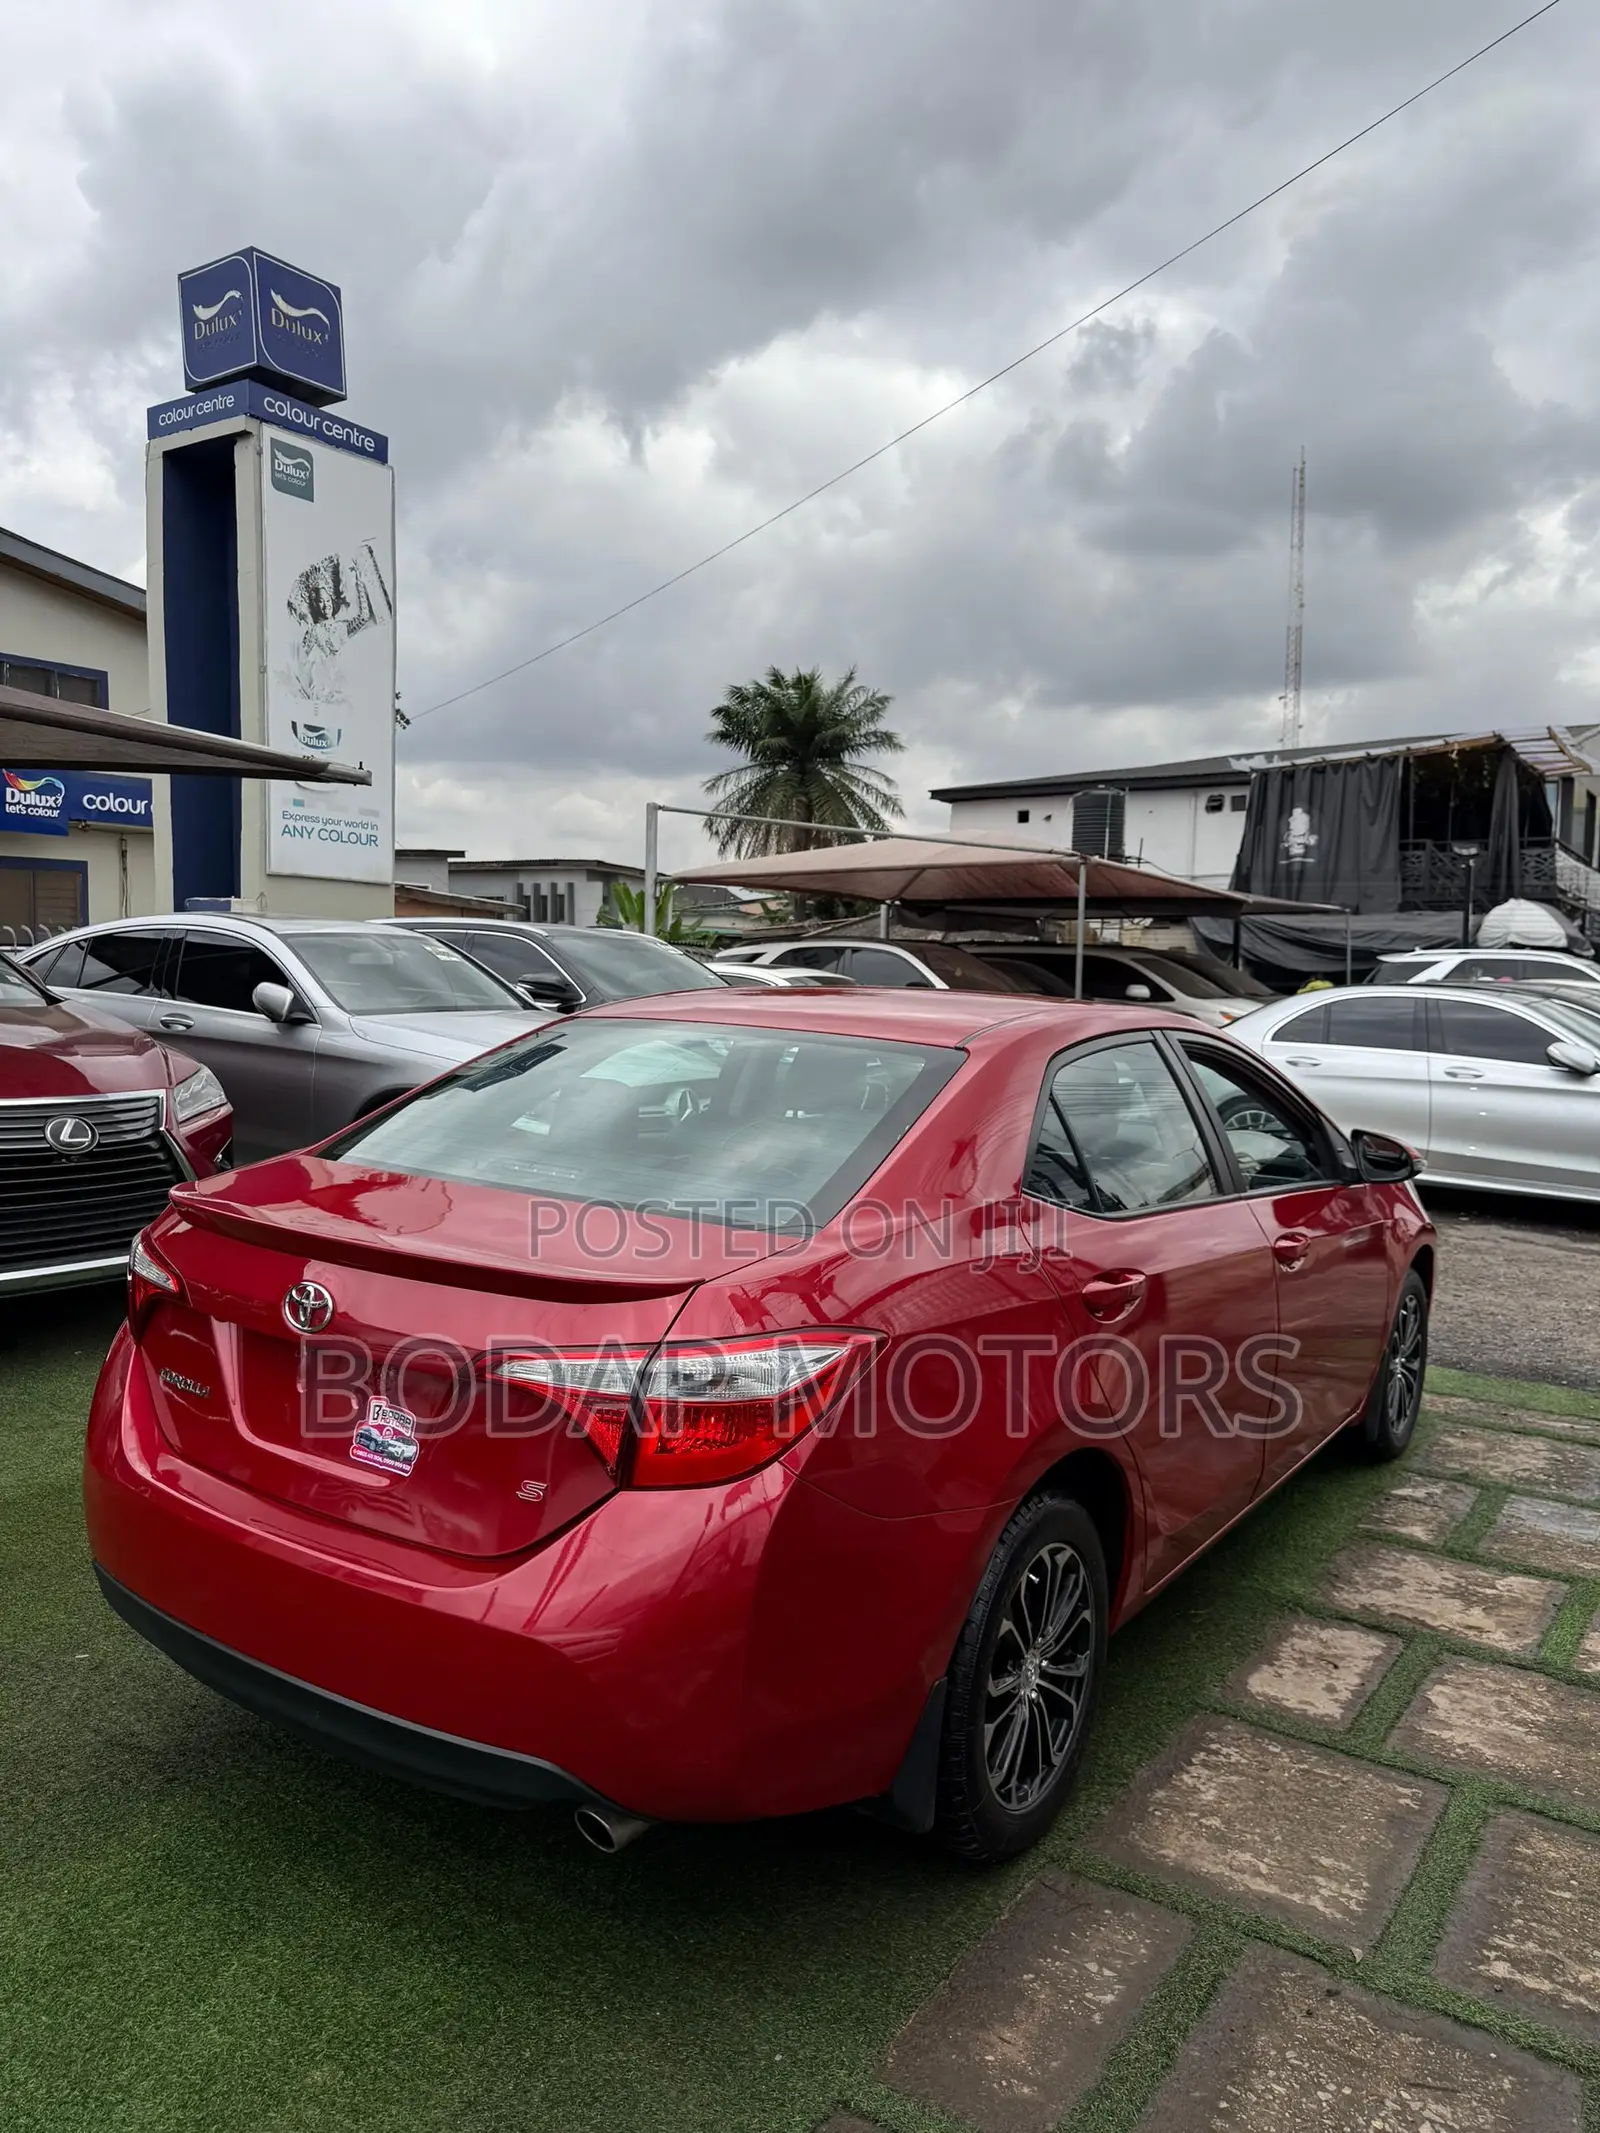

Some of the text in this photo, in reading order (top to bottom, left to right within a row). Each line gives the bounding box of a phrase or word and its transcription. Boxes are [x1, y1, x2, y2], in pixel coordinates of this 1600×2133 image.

[194, 315, 237, 340] Dulux
[271, 307, 323, 345] Dulux
[158, 394, 235, 426] colour centre
[263, 396, 376, 452] colour centre
[274, 459, 306, 479] Dulux
[300, 734, 328, 748] Dulux
[5, 787, 57, 808] Dulux
[82, 792, 149, 815] colour
[5, 804, 61, 818] let's colour
[282, 810, 379, 831] Express your world in
[281, 824, 379, 847] ANY COLOUR
[516, 1479, 547, 1502] S
